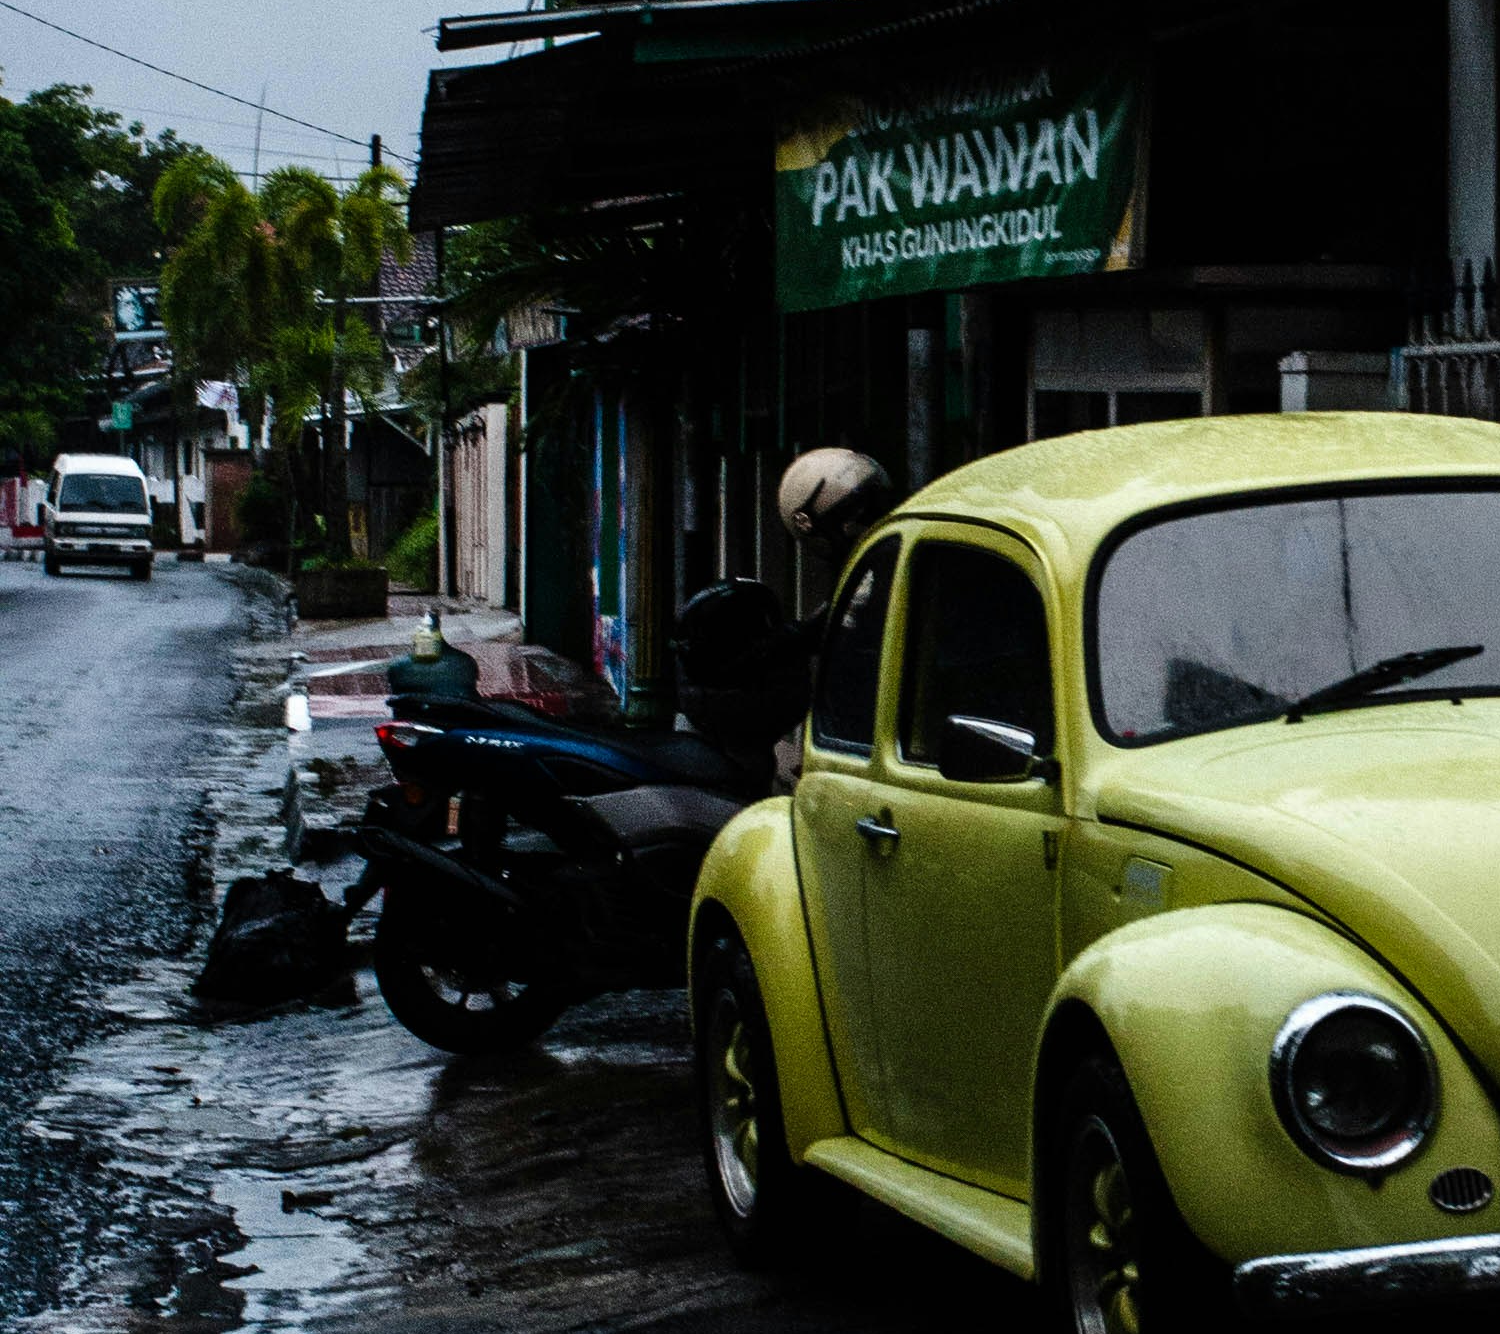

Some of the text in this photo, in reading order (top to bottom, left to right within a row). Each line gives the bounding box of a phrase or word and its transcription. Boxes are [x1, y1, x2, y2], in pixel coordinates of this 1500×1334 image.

[811, 107, 1099, 228] PAK WAWAN
[840, 228, 899, 270] KHAS
[901, 204, 1064, 260] GUNUNGKIDUL
